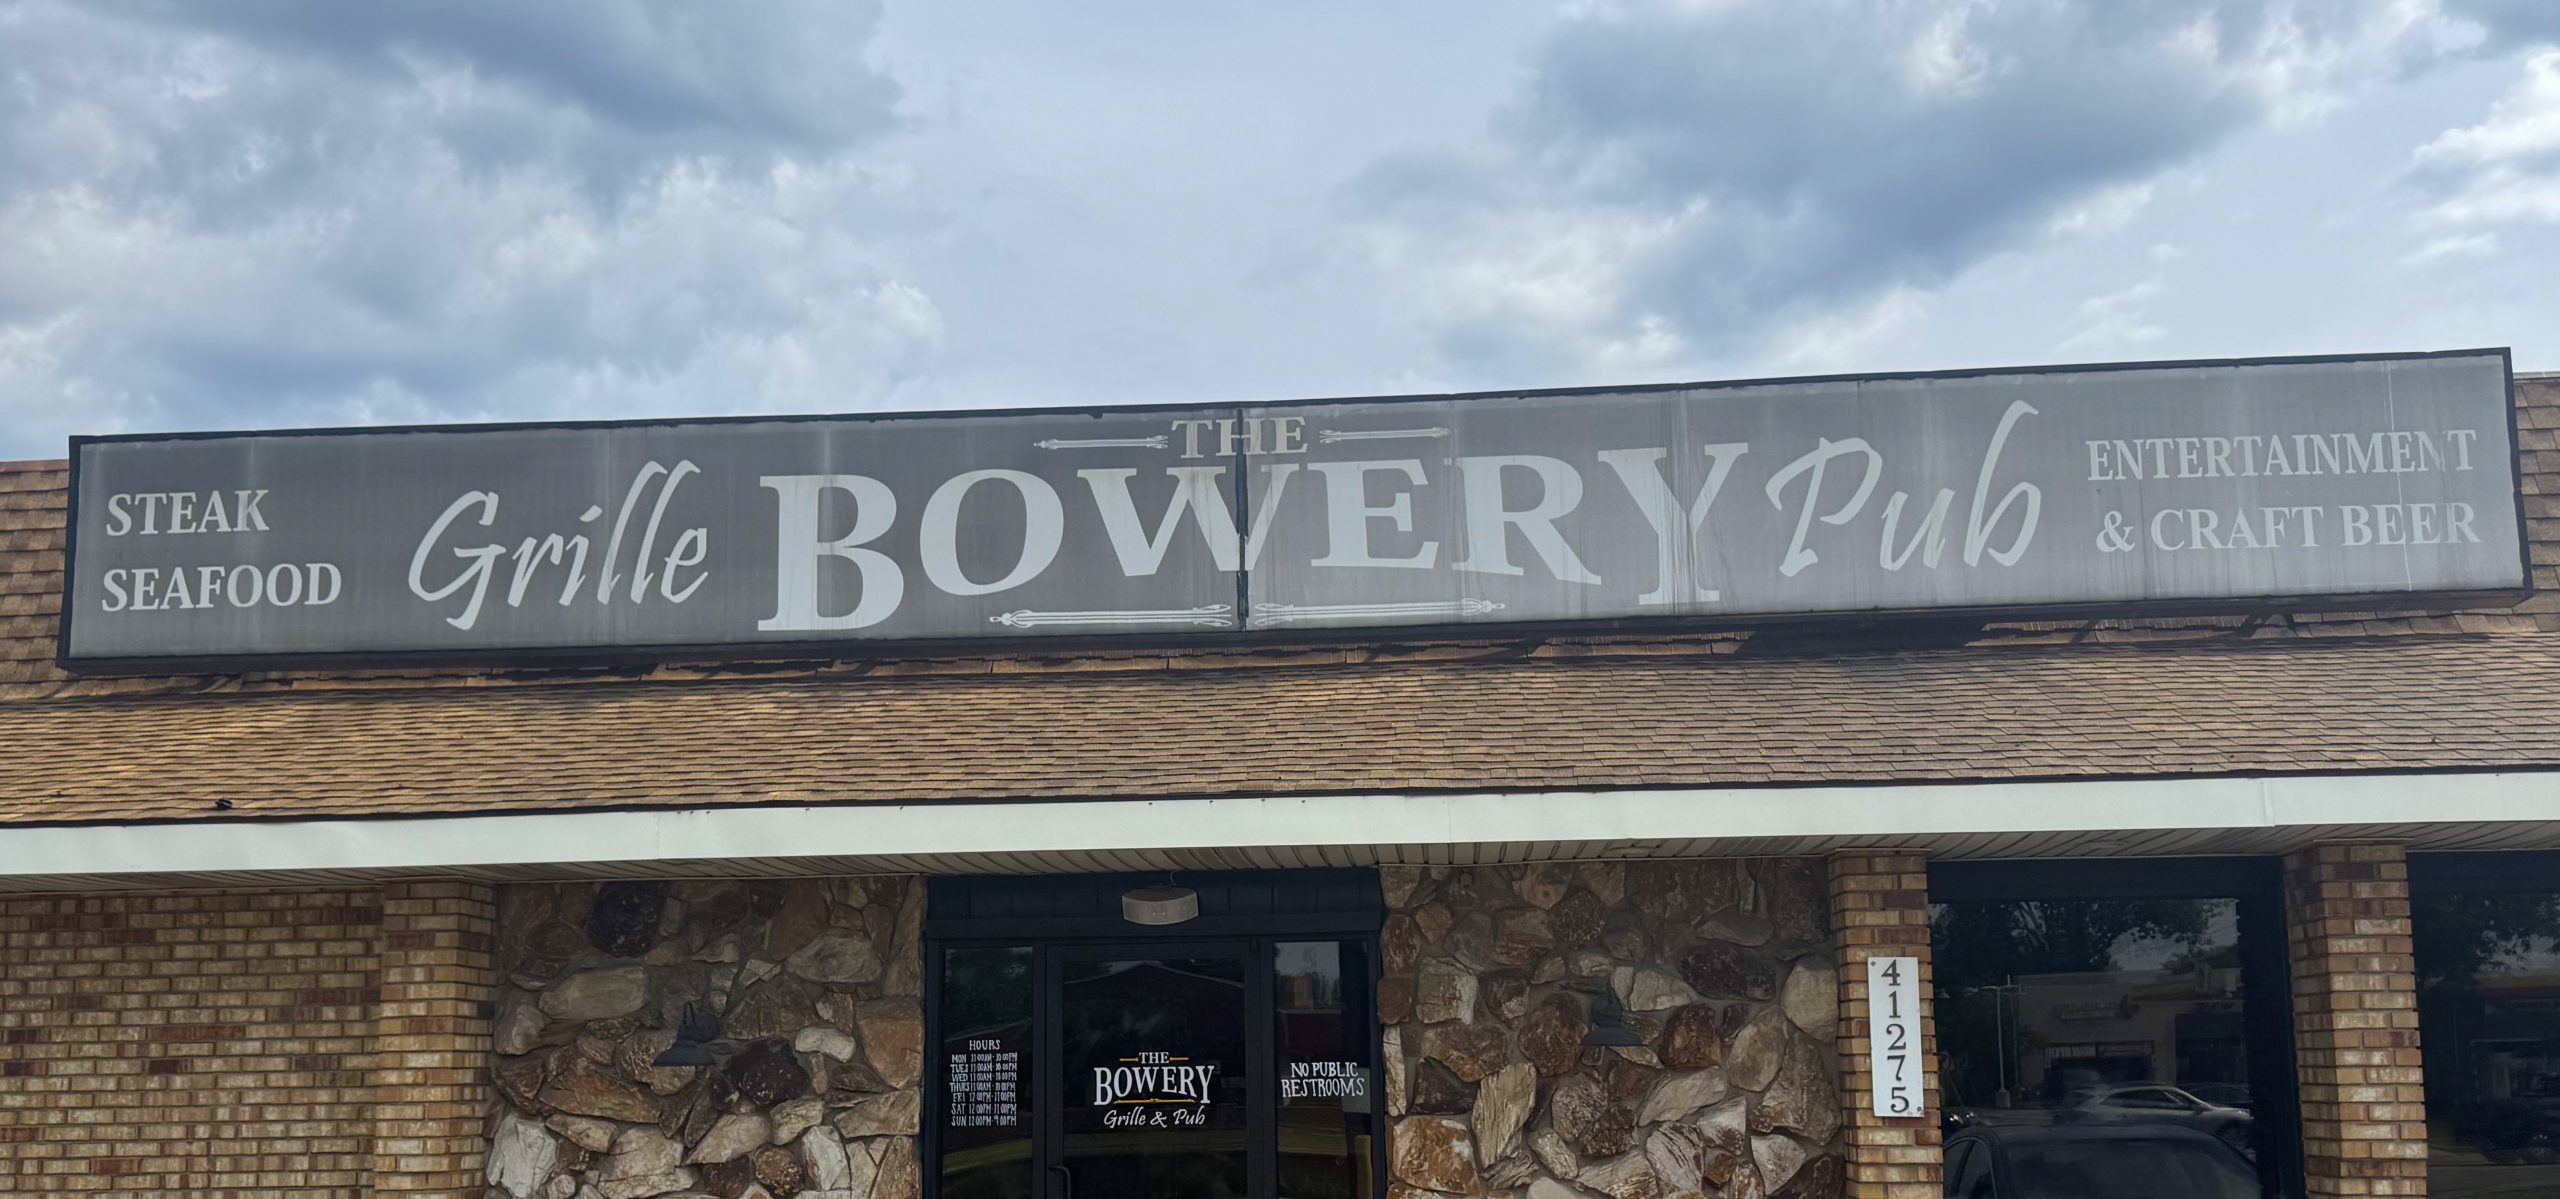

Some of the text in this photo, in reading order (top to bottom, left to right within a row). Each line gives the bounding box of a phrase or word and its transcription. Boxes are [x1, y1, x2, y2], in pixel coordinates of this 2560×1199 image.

[1171, 416, 1308, 458] THE
[2085, 429, 2477, 481] ENTERTAINMENT
[1765, 400, 2041, 577] Pub
[106, 489, 270, 537] STEAK
[757, 442, 1749, 632] BOWERY
[2095, 502, 2483, 553] & CRAFT BEER
[408, 459, 708, 631] Grille
[101, 562, 342, 612] SEAFOOD
[969, 1040, 1001, 1051] HOURS
[1881, 959, 1909, 1113] 41275
[950, 1064, 968, 1072] TUES
[952, 1054, 966, 1063] MON
[1139, 1052, 1169, 1063] THE
[952, 1073, 968, 1081] WED
[1290, 1062, 1358, 1077] NO PUBLIC
[949, 1082, 969, 1092] THURS
[1094, 1065, 1215, 1105] BOWERY
[1281, 1078, 1365, 1097] RESTROOMS
[953, 1093, 965, 1102] FRI
[951, 1103, 966, 1114] SAT
[1103, 1105, 1206, 1128] Grille & Pub
[951, 1115, 966, 1126] SUN
